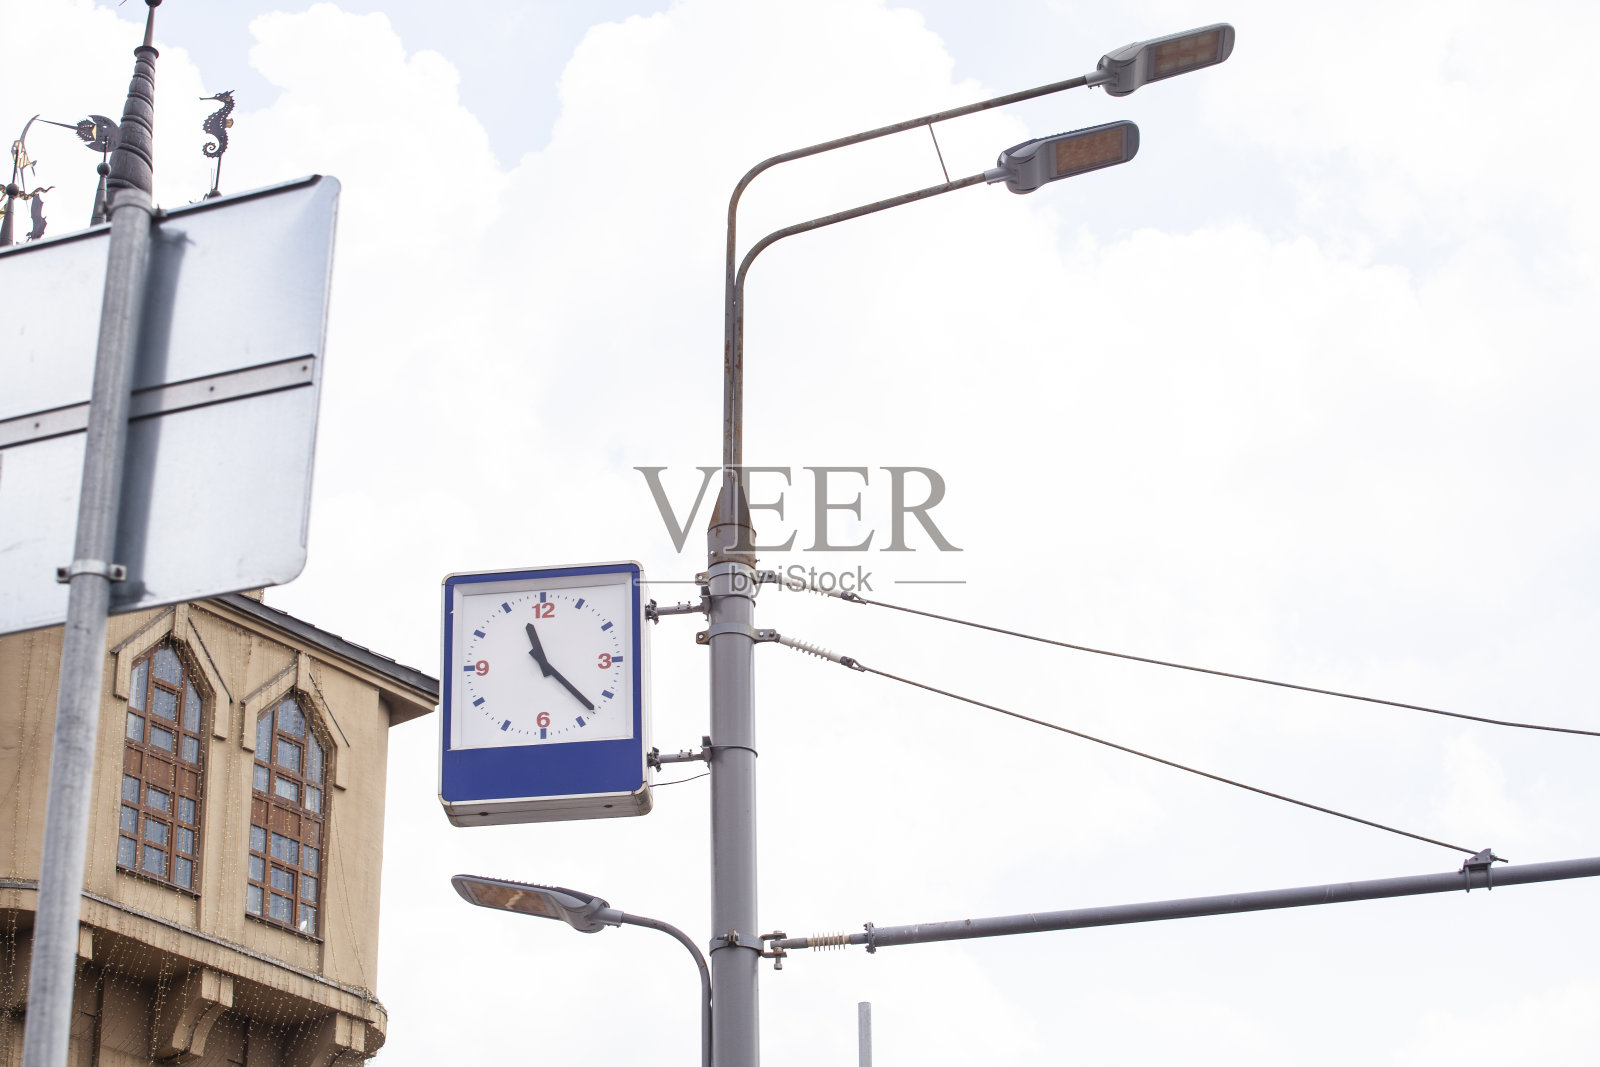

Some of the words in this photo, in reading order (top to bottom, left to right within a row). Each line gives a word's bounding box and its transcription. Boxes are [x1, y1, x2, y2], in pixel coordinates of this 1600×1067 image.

[532, 602, 555, 619] 12
[475, 660, 489, 676] 9
[598, 653, 612, 669] 3
[536, 712, 551, 728] 6
